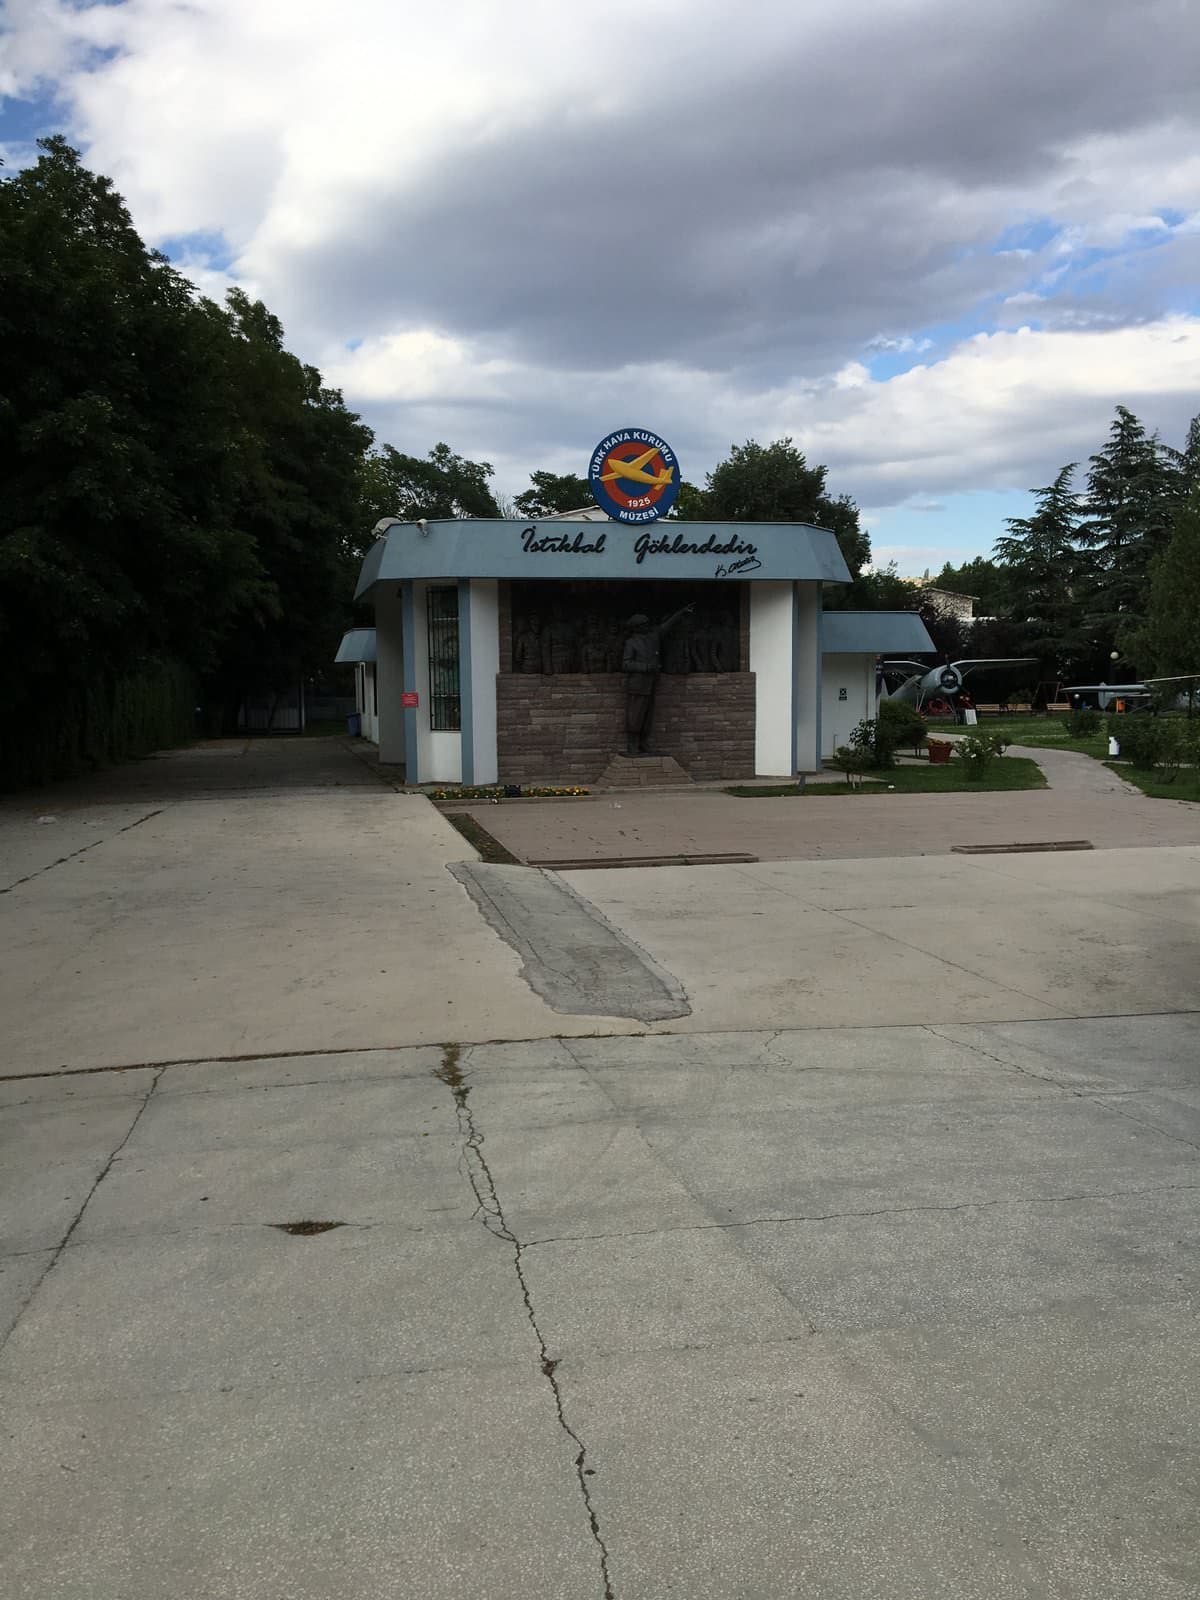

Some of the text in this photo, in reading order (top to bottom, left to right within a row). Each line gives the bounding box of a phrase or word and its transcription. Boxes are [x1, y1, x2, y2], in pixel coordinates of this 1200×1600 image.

[603, 433, 631, 450] HAVA
[633, 431, 673, 462] KURUMU
[627, 496, 651, 507] 1925
[634, 533, 757, 564] Göklerdedir
